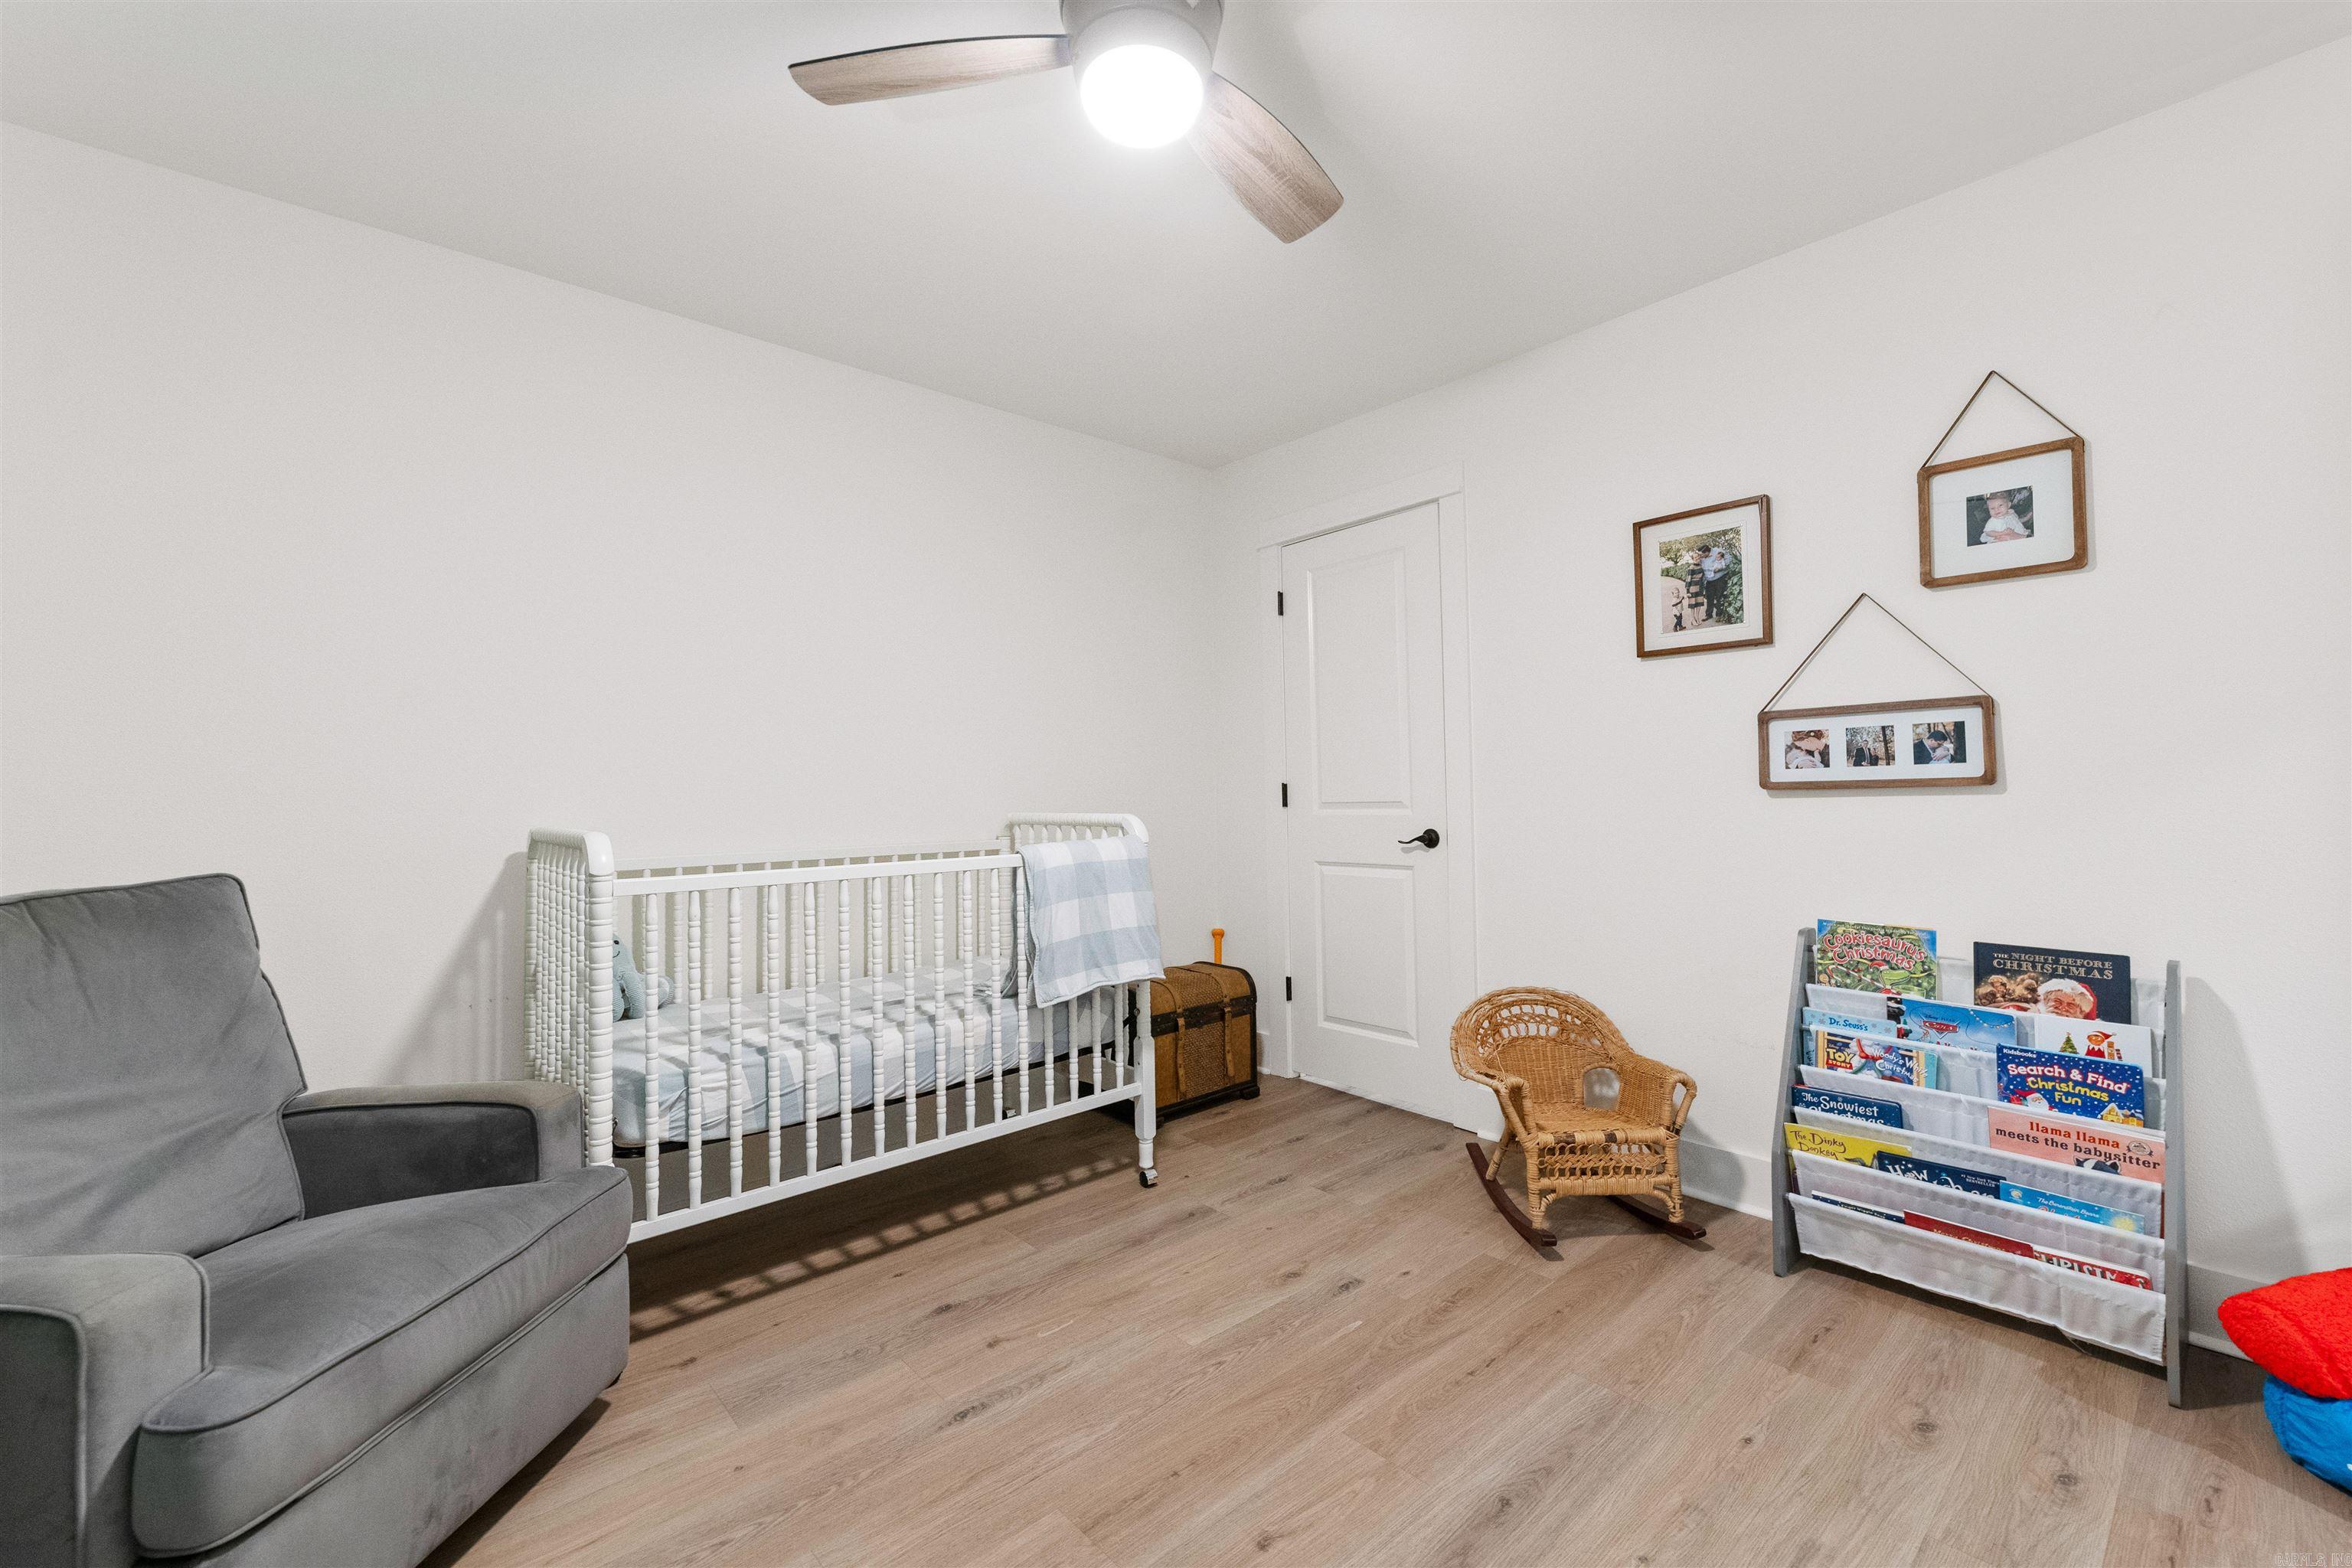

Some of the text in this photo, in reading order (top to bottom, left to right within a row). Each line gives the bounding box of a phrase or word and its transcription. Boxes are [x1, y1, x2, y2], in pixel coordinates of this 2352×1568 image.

[1823, 930, 1926, 962] Cookiesaurus
[1832, 946, 1916, 971] Christmas
[1992, 959, 2113, 980] CHRISTMAS
[2011, 952, 2055, 963] NIGHT
[2060, 957, 2113, 969] BEFORE
[1828, 1017, 1868, 1031] Dr. Seuss's
[1826, 1048, 1855, 1063] TOY
[1872, 1047, 1904, 1064] Woody's
[2003, 1048, 2037, 1058] Kidsbooks
[1828, 1060, 1851, 1069] STORY
[1876, 1060, 1919, 1083] Christmas
[2007, 1063, 2128, 1095] Search & Find
[2027, 1076, 2109, 1102] Christmas
[1801, 1092, 1879, 1116] The Snowiest
[2054, 1092, 2082, 1106] Fun
[1789, 1130, 1847, 1153] The Dinky
[2029, 1121, 2071, 1139] llama
[2076, 1131, 2120, 1148] llama
[1798, 1142, 1838, 1160] Donkey
[1995, 1128, 2039, 1144] meets
[2044, 1137, 2069, 1150] the
[2073, 1142, 2161, 1169] babysitter
